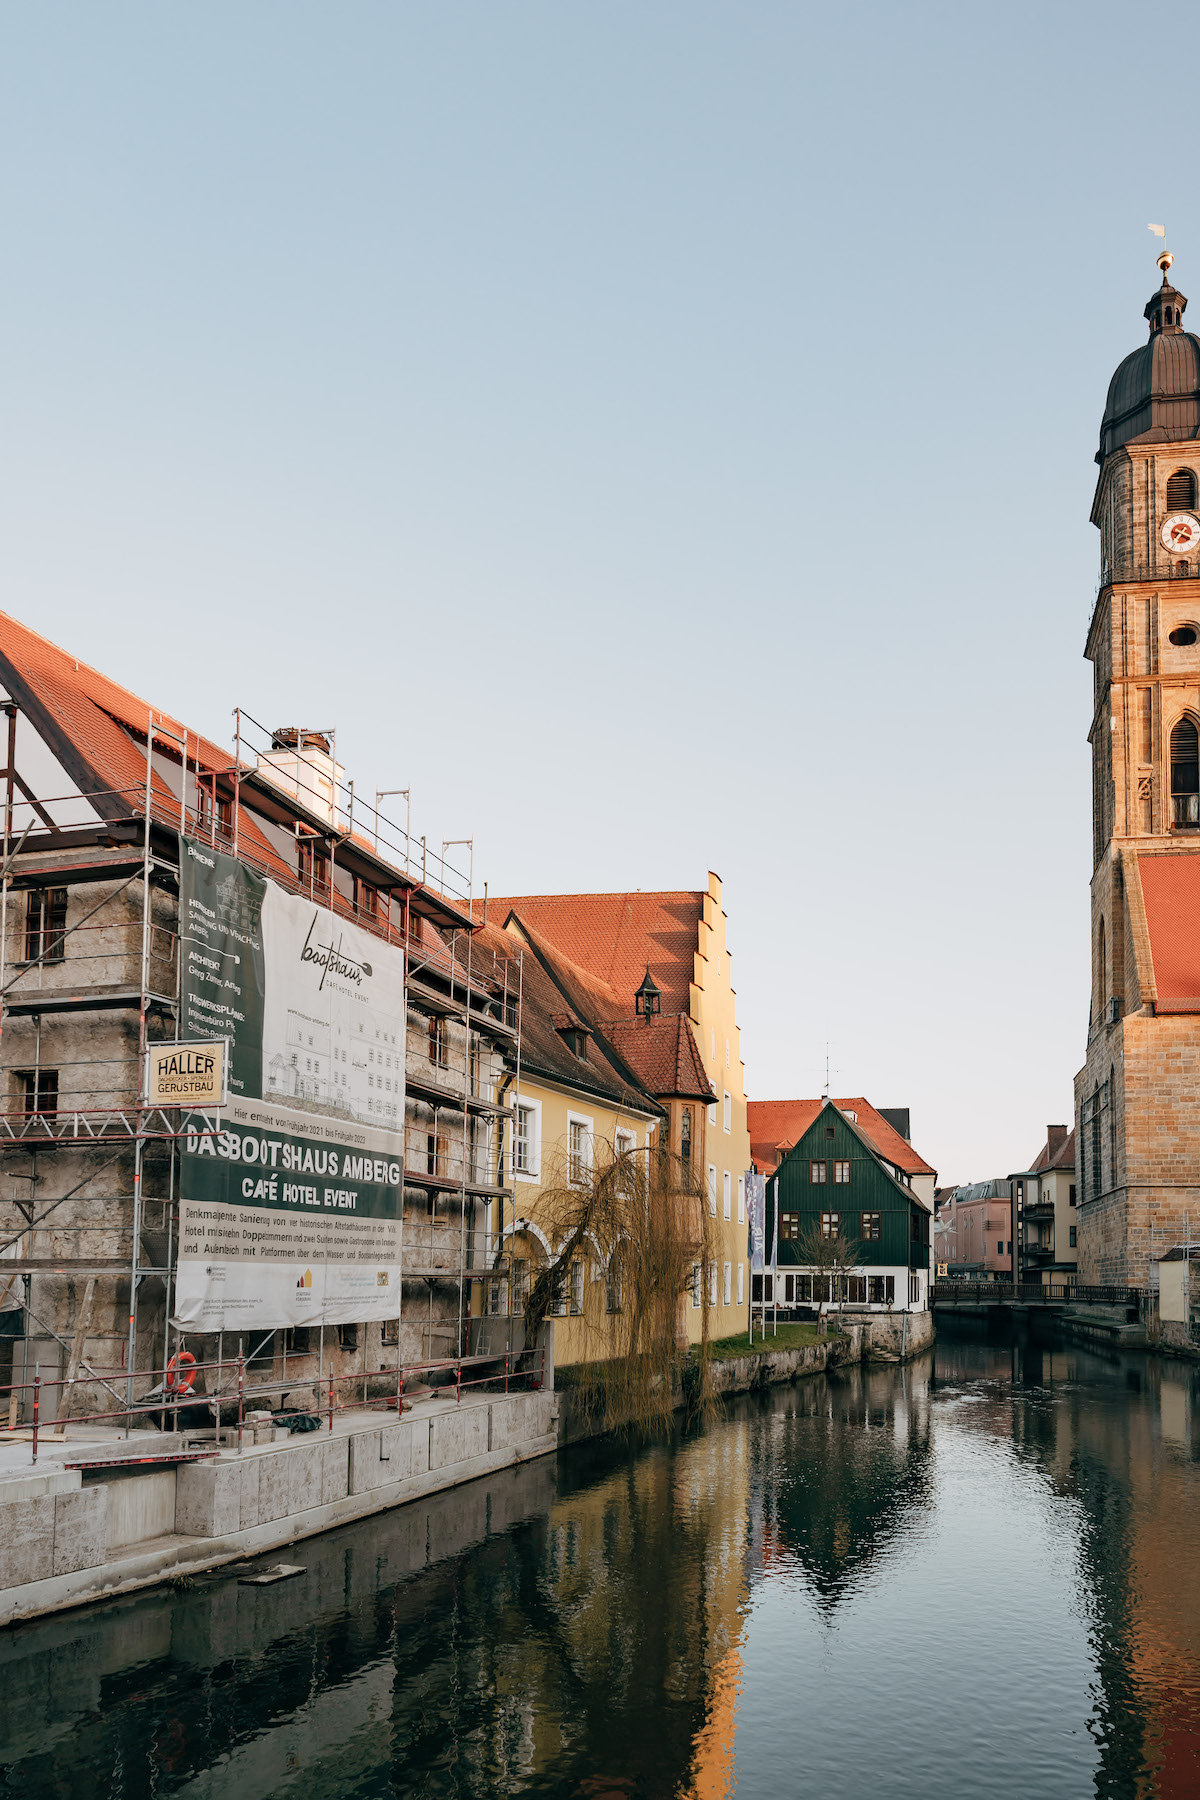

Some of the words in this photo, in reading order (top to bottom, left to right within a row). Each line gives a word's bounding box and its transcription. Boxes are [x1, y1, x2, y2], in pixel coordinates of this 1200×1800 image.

[158, 1053, 214, 1075] HALLER
[157, 1082, 214, 1093] GERÜSTBAU
[234, 1107, 248, 1119] Hier
[309, 1125, 323, 1136] 2021
[325, 1128, 334, 1138] bis
[354, 1134, 366, 1144] 2023
[186, 1123, 230, 1158] DAS
[229, 1133, 339, 1176] BOOTSHAUS
[342, 1154, 400, 1185] AMBERG
[241, 1173, 279, 1201] CAFÉ
[282, 1182, 321, 1206] HOTEL
[323, 1188, 358, 1209] EVENT
[272, 1218, 286, 1226] von
[299, 1217, 334, 1230] historischen
[184, 1225, 205, 1237] Hotel
[303, 1234, 316, 1243] zwei
[316, 1234, 334, 1244] Suiten
[334, 1235, 349, 1245] sowie
[184, 1243, 198, 1254] und
[242, 1245, 256, 1256] mit
[297, 1248, 310, 1258] über
[312, 1249, 325, 1258] dem
[326, 1250, 345, 1259] Wasser
[346, 1250, 356, 1259] und
